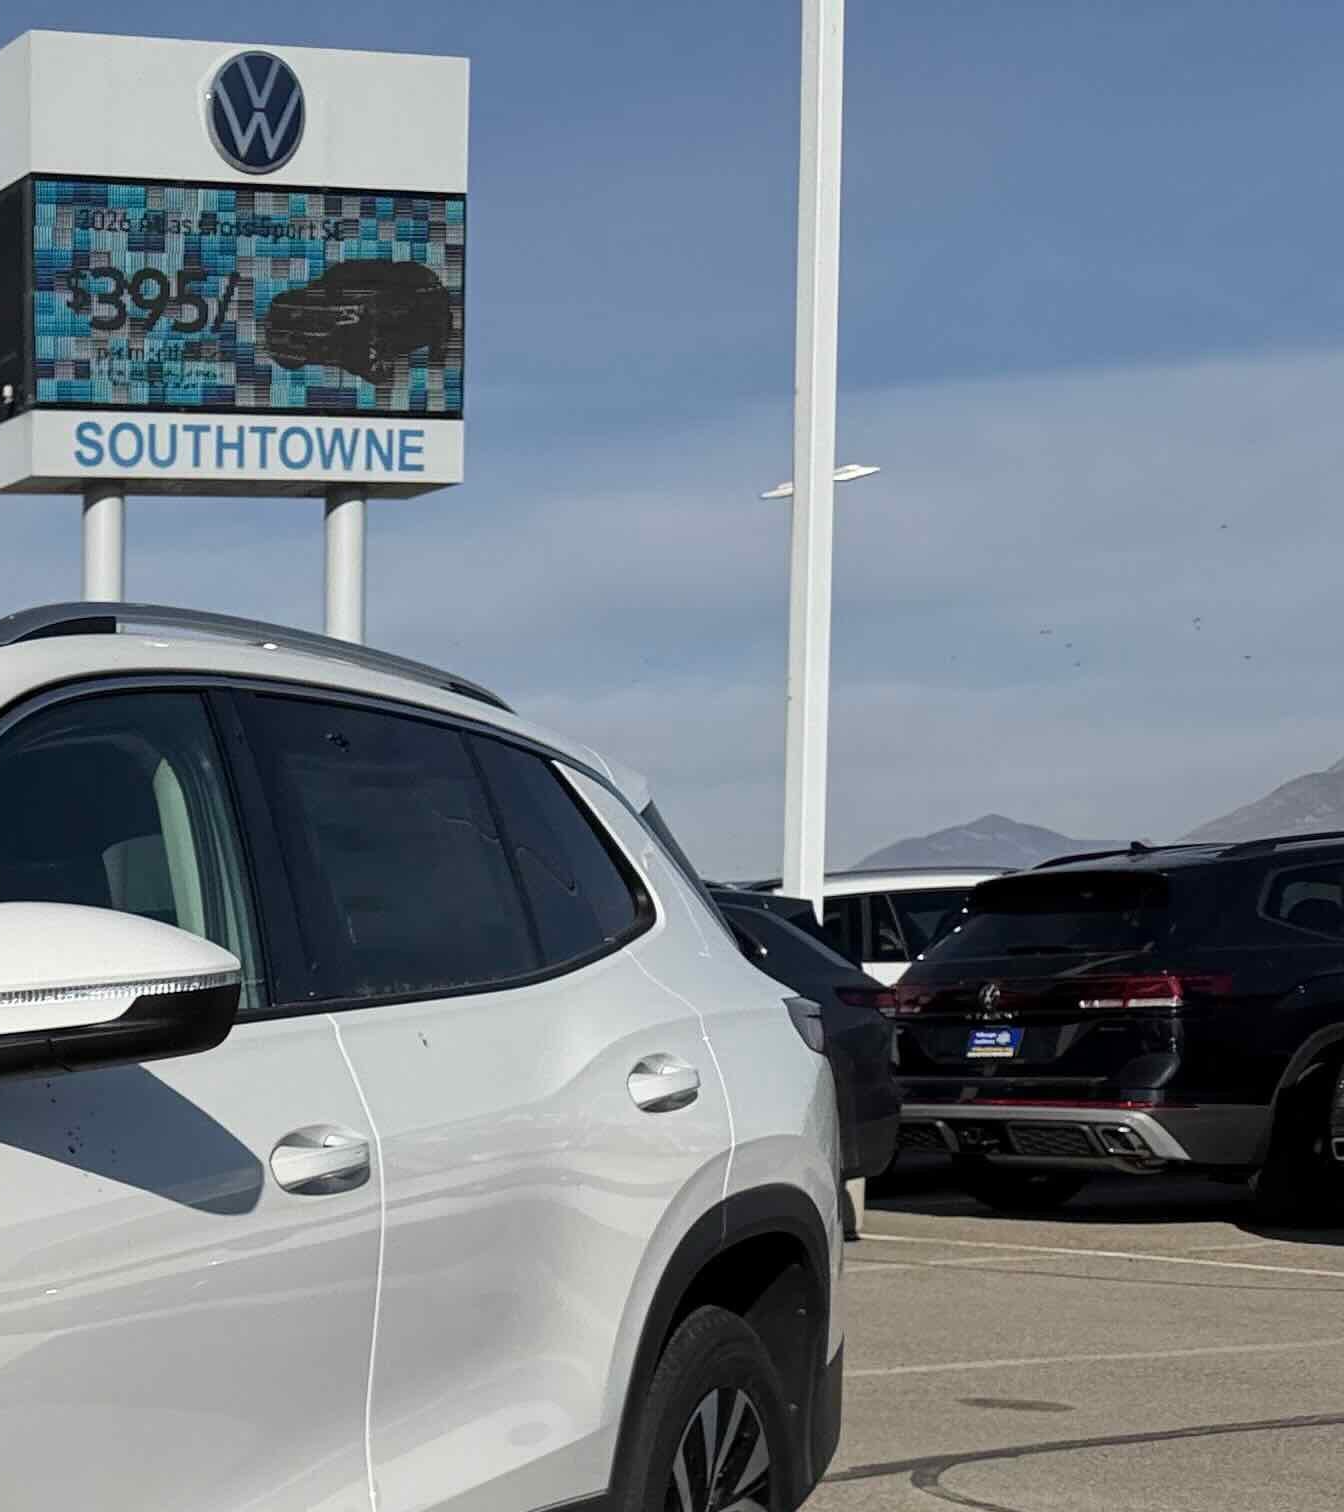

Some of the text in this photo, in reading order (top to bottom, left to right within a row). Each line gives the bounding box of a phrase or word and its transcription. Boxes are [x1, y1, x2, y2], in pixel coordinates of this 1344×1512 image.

[206, 50, 305, 175] VW
[77, 209, 129, 232] 2026
[73, 421, 425, 472] SOUTHTOWNE
